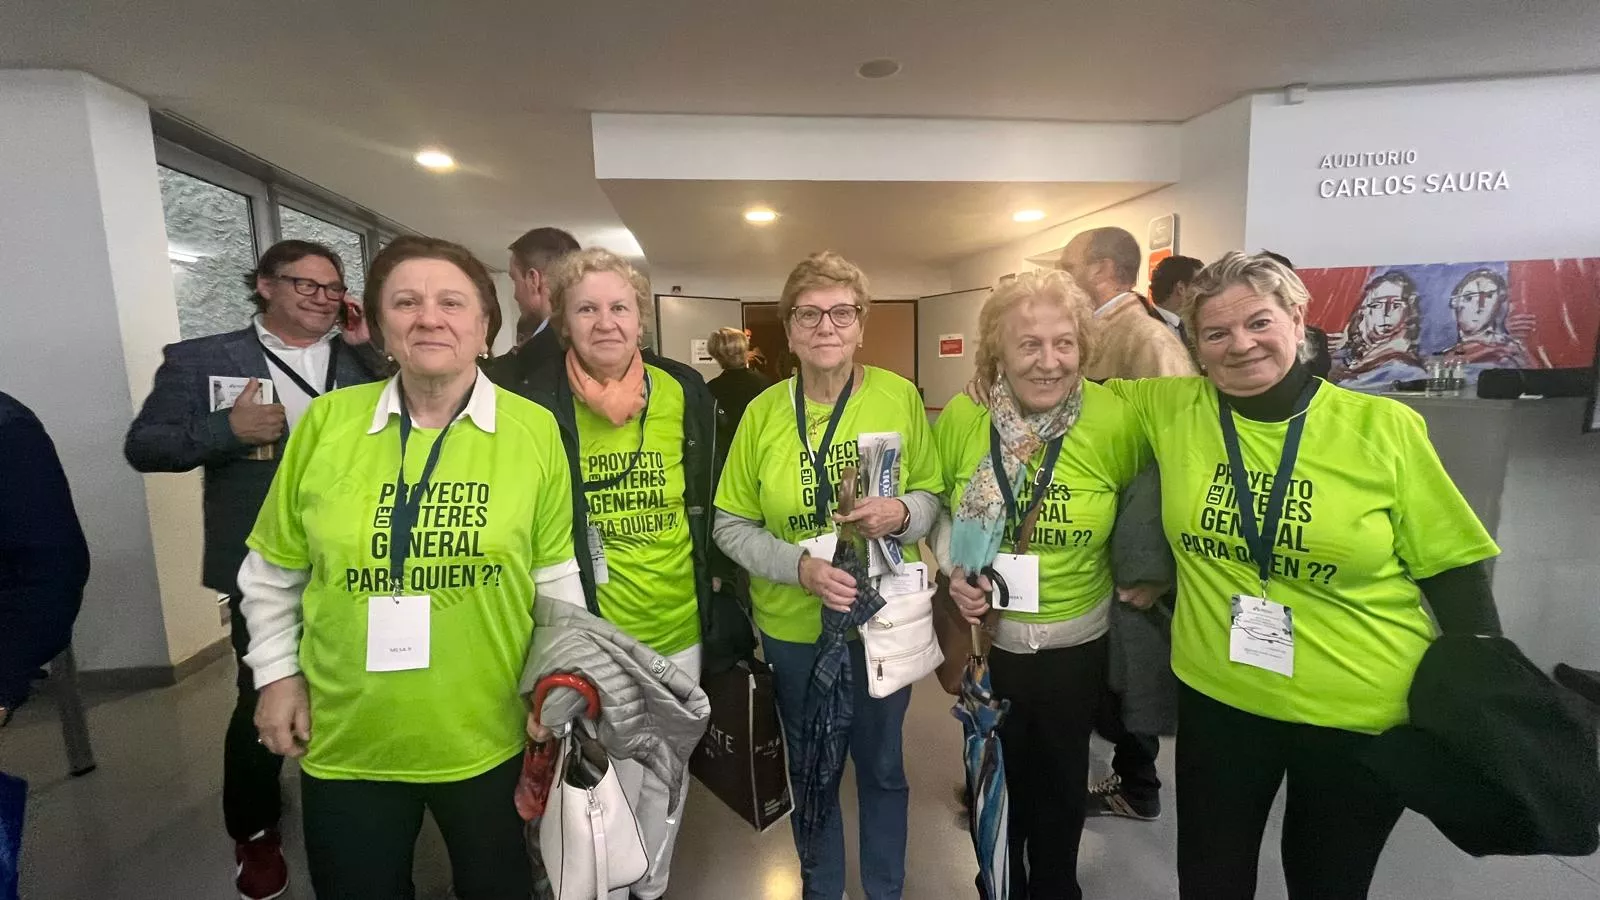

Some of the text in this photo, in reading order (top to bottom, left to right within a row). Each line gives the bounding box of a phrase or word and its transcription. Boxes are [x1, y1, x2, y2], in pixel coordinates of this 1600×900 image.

[1319, 150, 1417, 169] AUDITORIO
[1319, 170, 1510, 198] CARLOS SAURA
[800, 440, 859, 467] PYECT
[1213, 463, 1313, 500] PYETO
[590, 489, 668, 515] GENERAL
[1225, 487, 1312, 523] IEES
[396, 505, 487, 528] TERES
[621, 514, 663, 535] QUIEN
[1200, 507, 1310, 552] GENAL
[371, 531, 484, 559] GNERAL
[1072, 529, 1093, 547] ??
[1181, 532, 1338, 584] PARA QEN ??
[410, 564, 476, 591] QUIEN
[481, 564, 503, 587] ??
